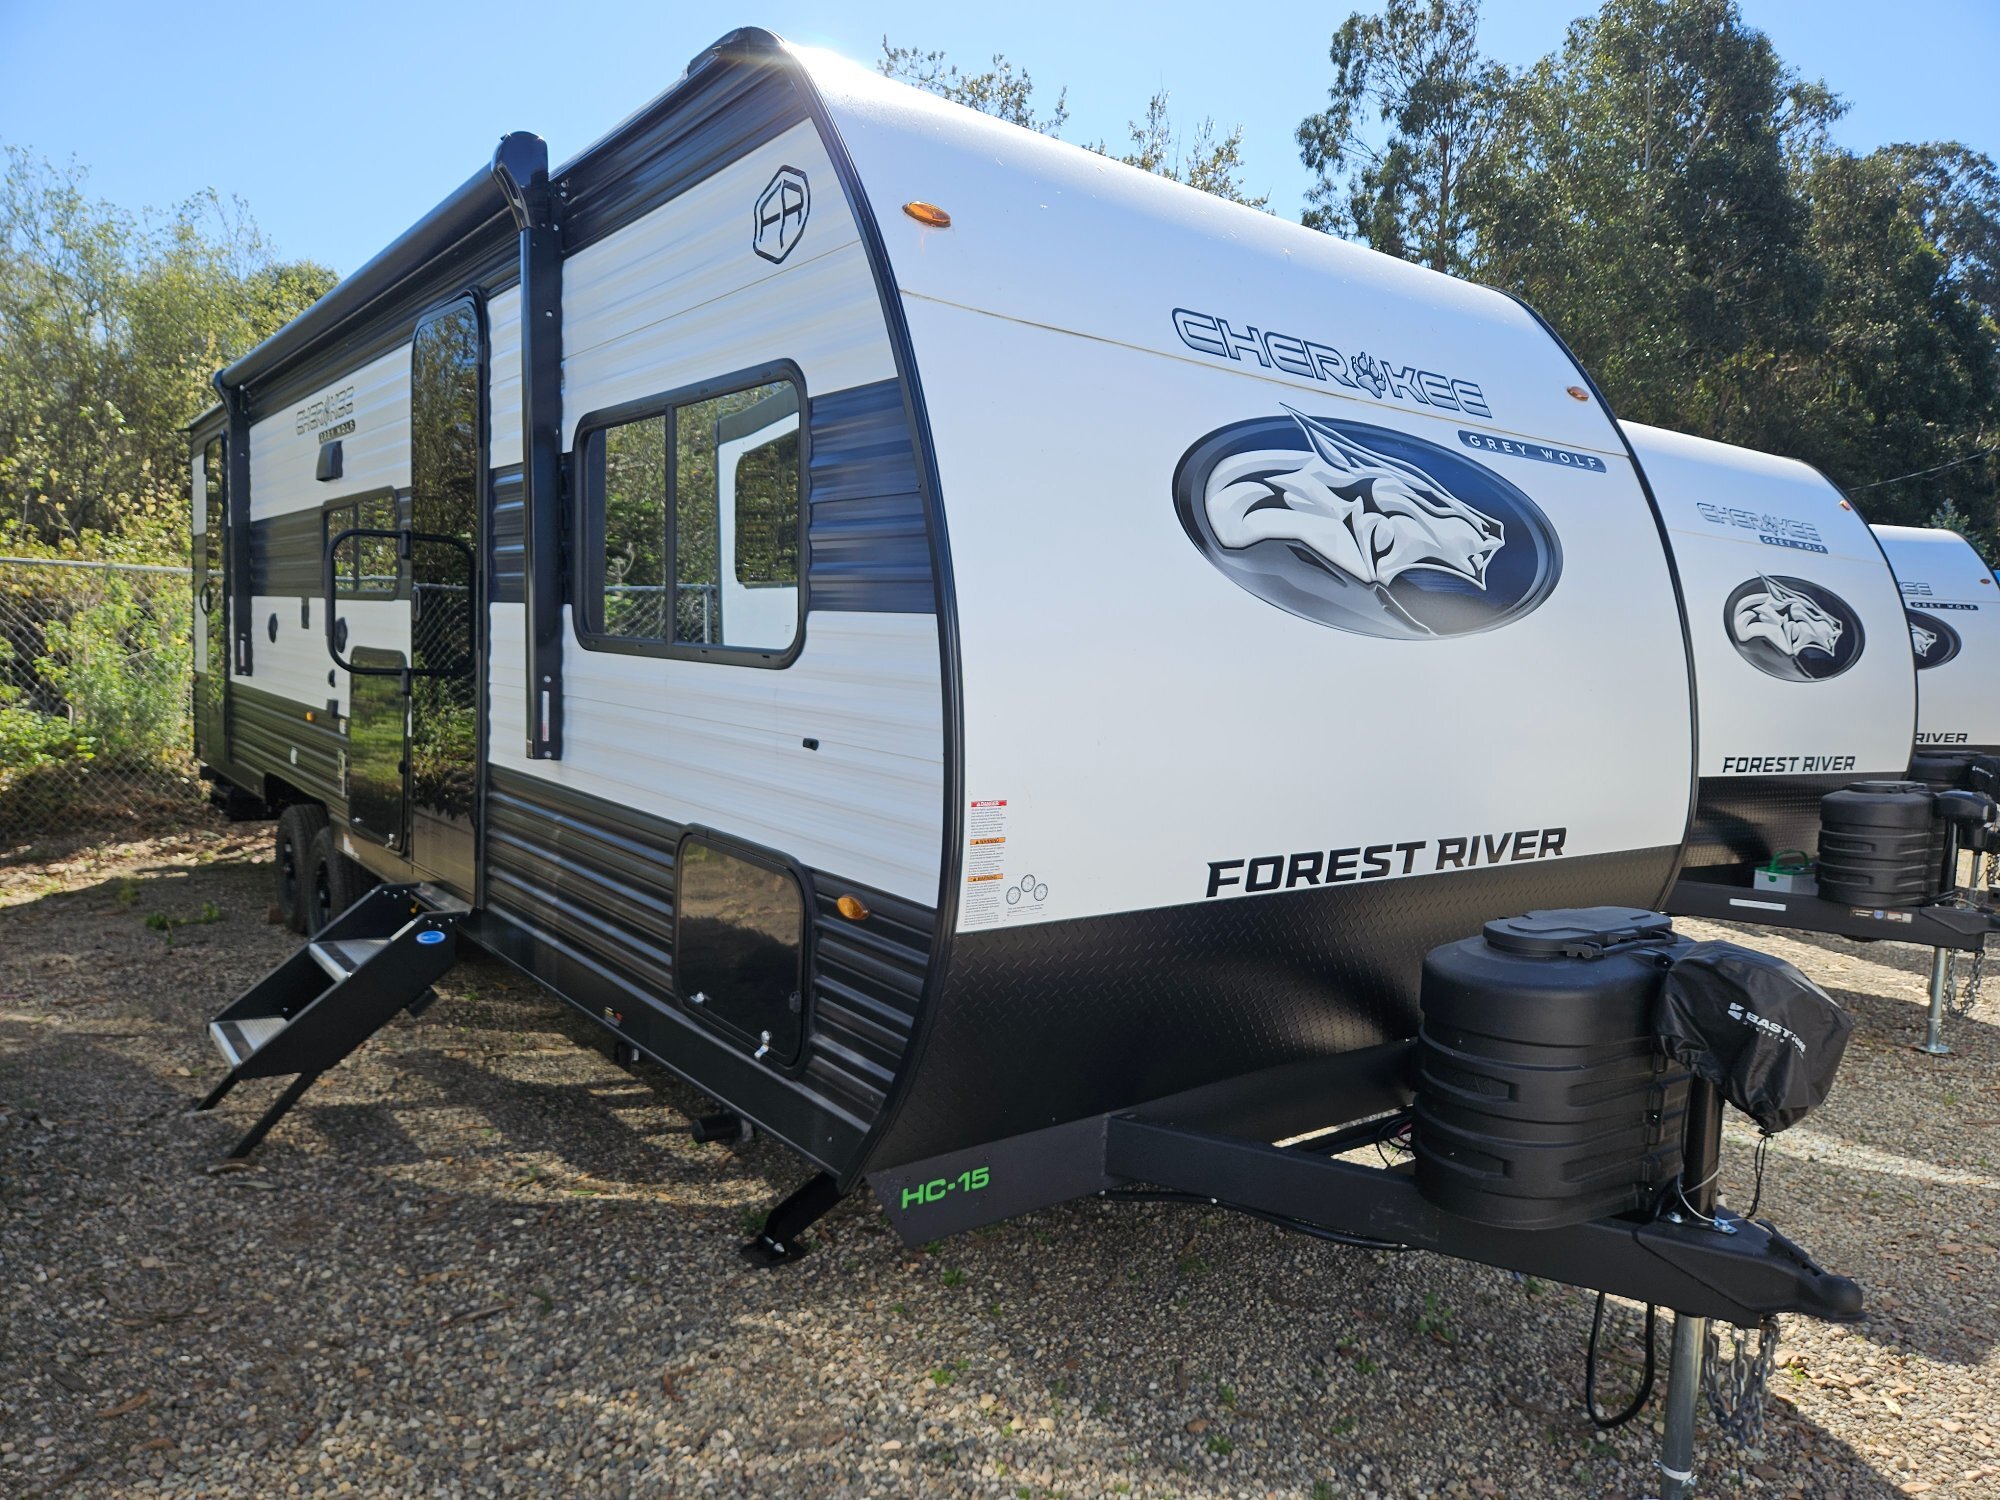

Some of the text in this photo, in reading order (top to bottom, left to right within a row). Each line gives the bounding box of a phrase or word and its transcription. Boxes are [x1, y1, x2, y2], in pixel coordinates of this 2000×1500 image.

[1468, 433, 1598, 469] GREY WOLF
[1915, 732, 1968, 743] RIVER
[1722, 755, 1856, 773] FOREST RIVER
[1206, 827, 1567, 898] FOREST RIVER
[902, 1166, 990, 1210] HC-15
